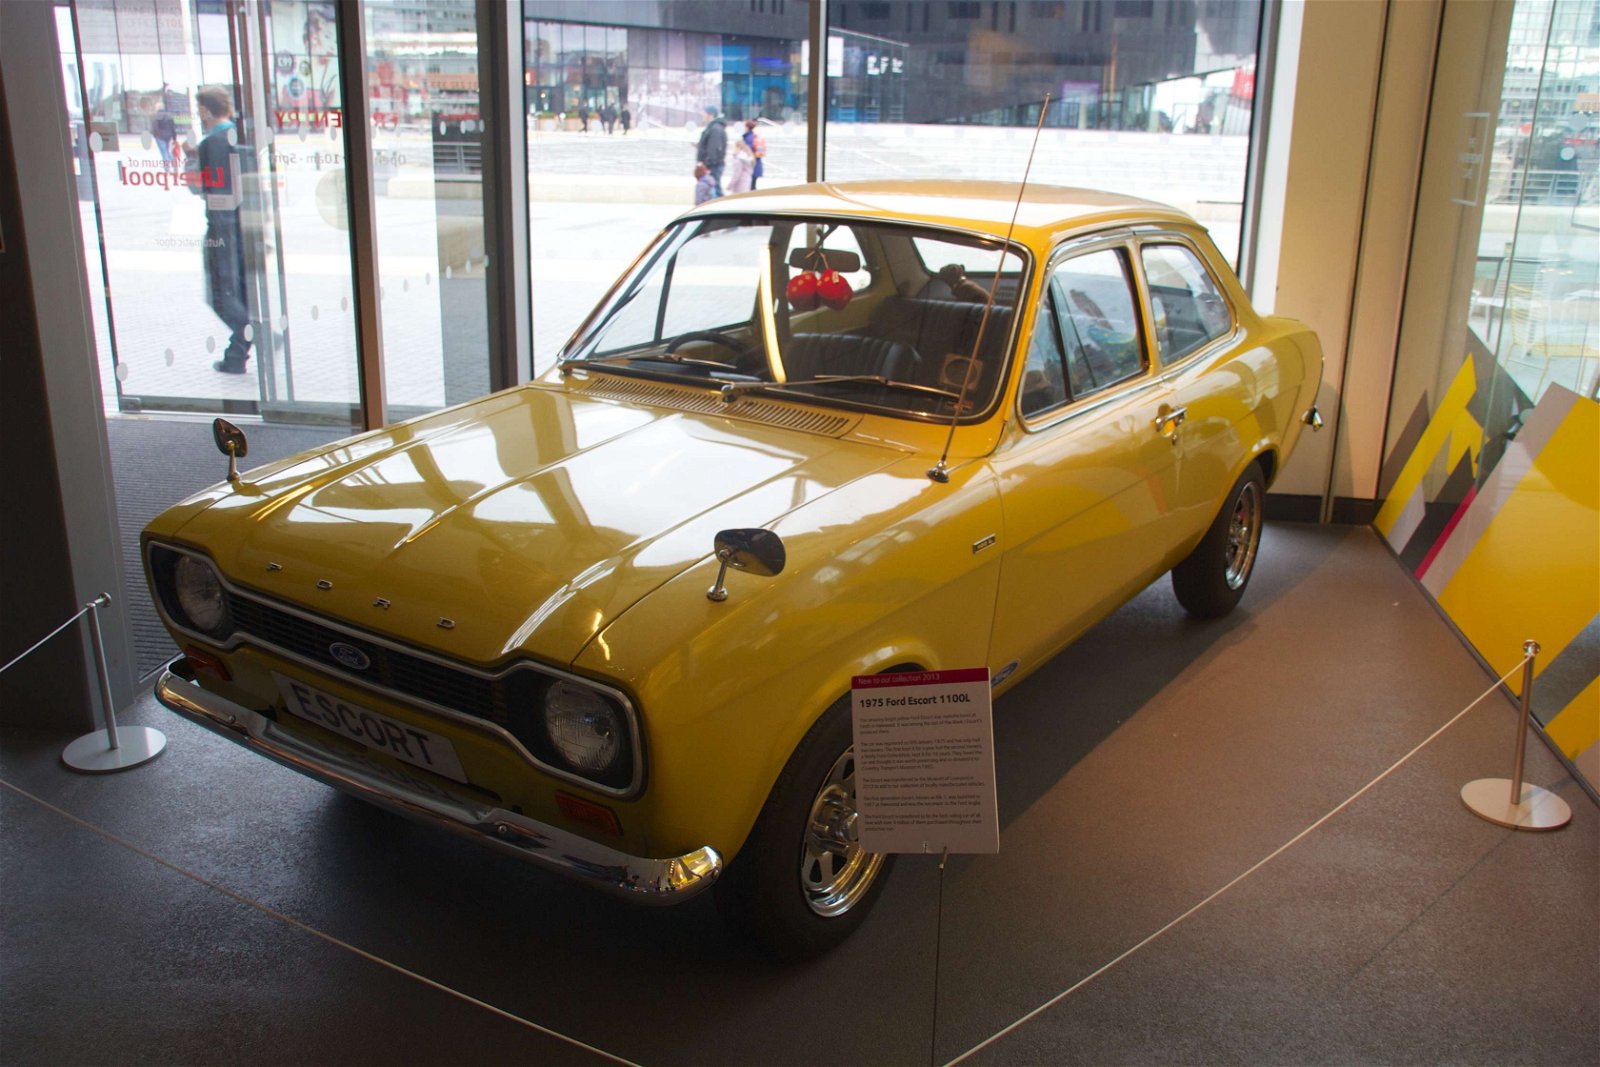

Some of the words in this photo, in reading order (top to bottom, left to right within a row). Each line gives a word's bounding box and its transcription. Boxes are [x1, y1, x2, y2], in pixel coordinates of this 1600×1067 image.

[266, 561, 456, 629] FORD
[872, 676, 880, 685] to
[892, 674, 922, 684] collection
[922, 673, 941, 682] 2013
[859, 698, 883, 708] 1975
[886, 696, 905, 707] Ford
[908, 695, 937, 706] Escort
[940, 693, 971, 704] 1100L
[290, 682, 432, 765] ESCORT
